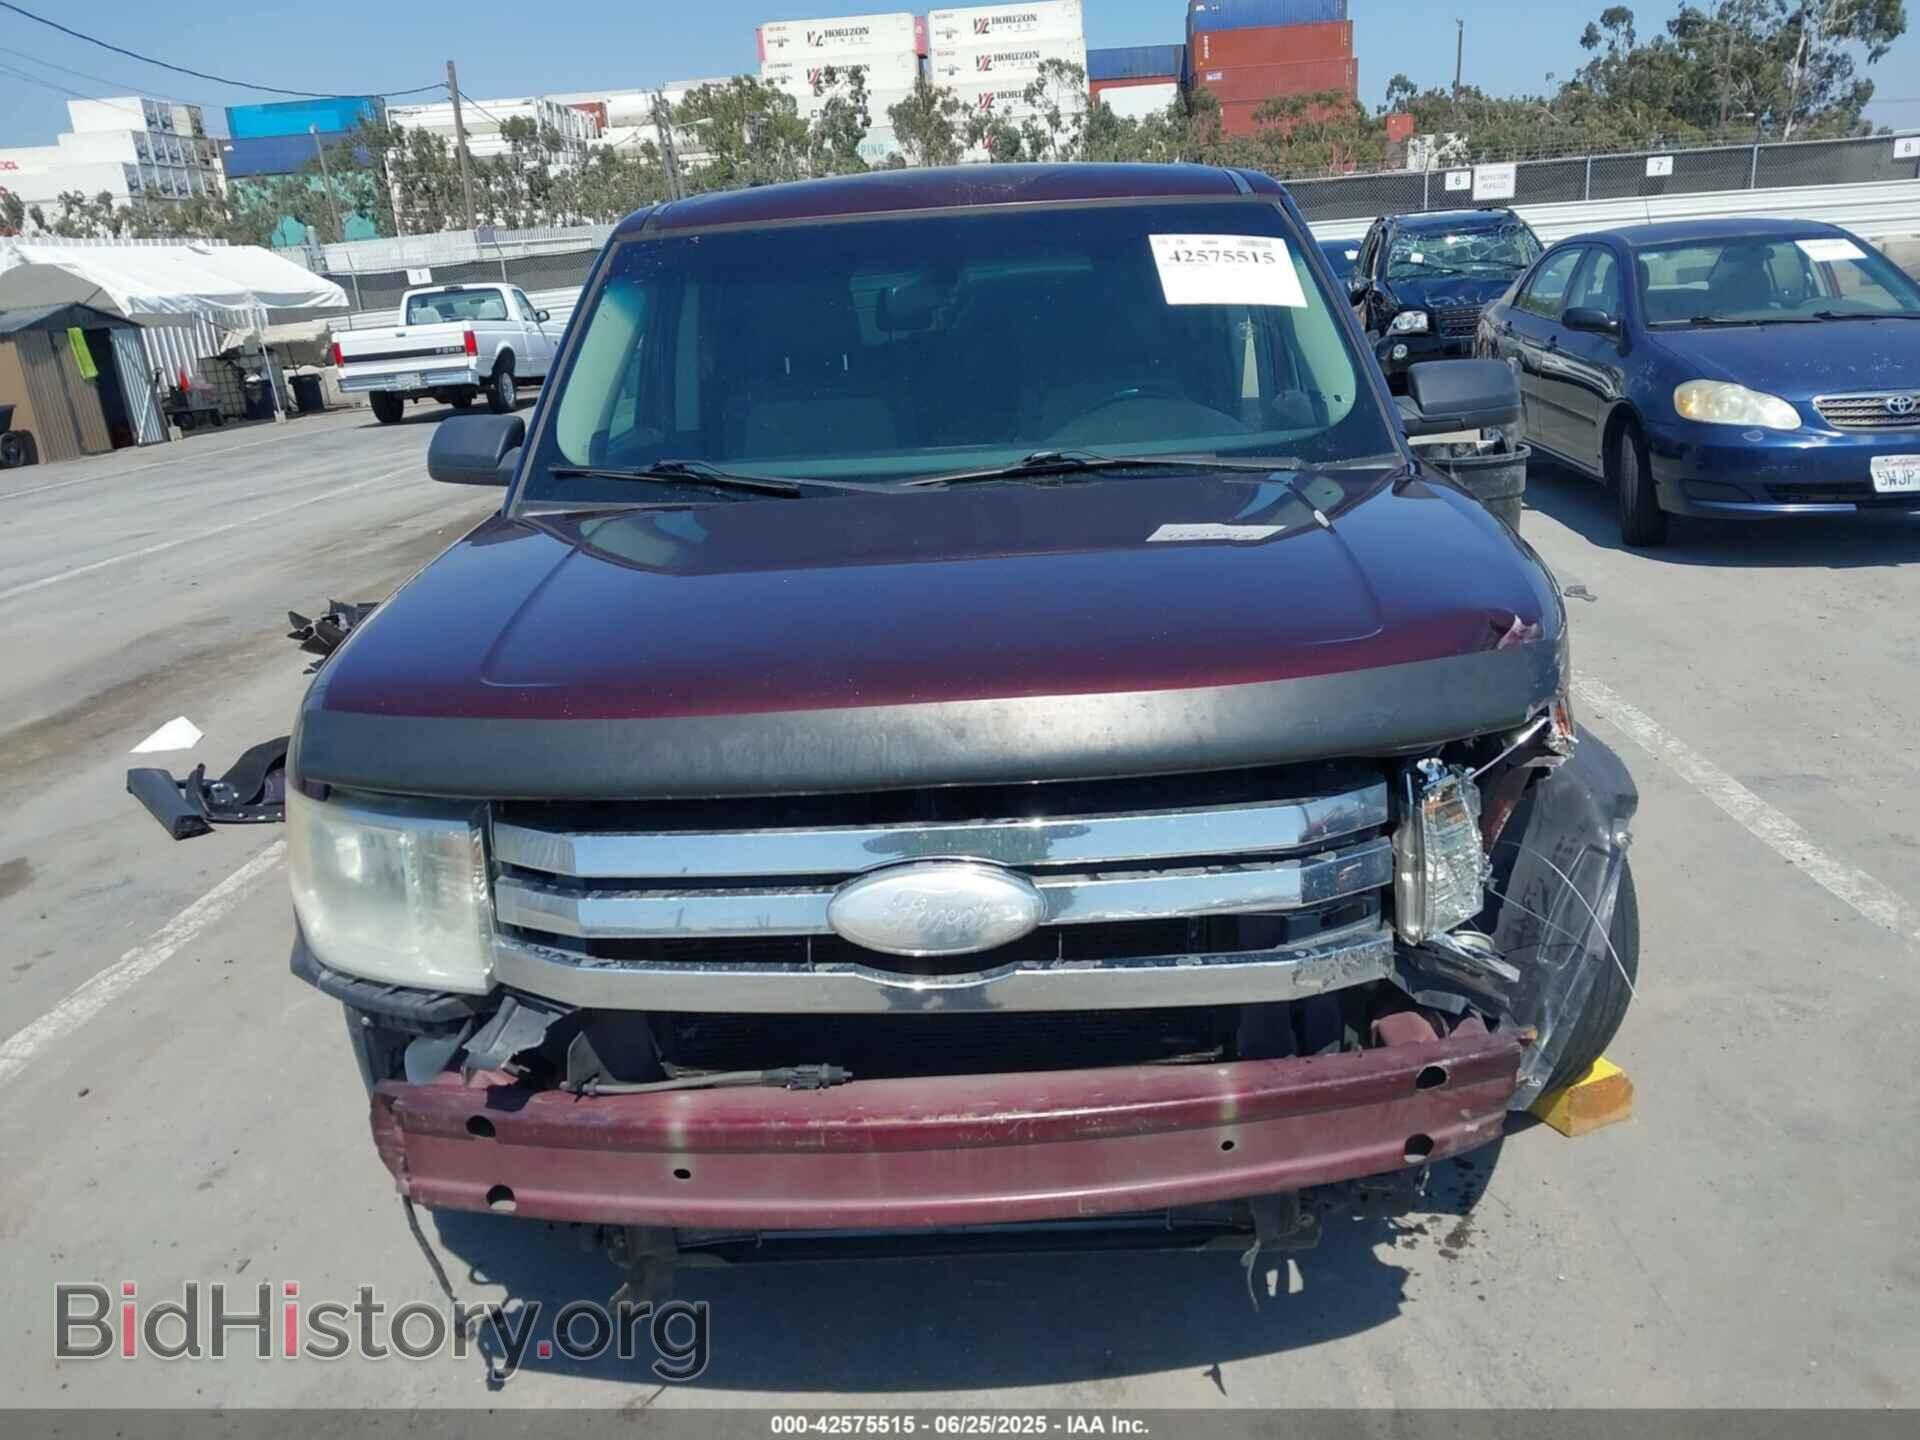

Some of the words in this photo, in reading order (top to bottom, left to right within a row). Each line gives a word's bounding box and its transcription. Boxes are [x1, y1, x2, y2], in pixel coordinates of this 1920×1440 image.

[991, 13, 1037, 25] HORIZON
[824, 25, 870, 38] HORIZON
[993, 50, 1040, 62] HORIZON
[1903, 142, 1912, 153] 8
[1655, 159, 1664, 171] 7
[1454, 174, 1462, 186] 6
[1168, 249, 1276, 265] 42575515
[1876, 469, 1920, 487] 5WJP
